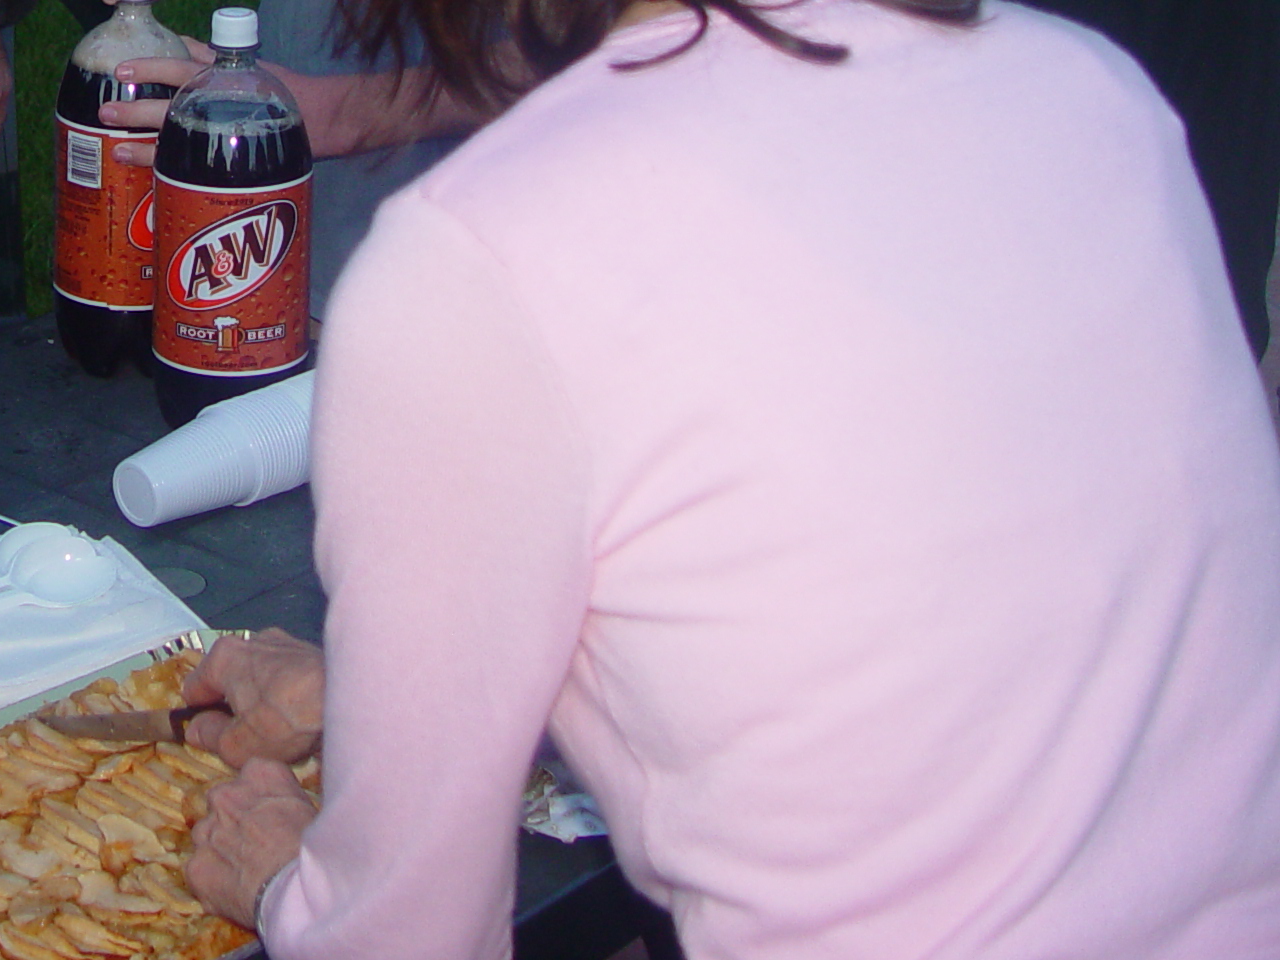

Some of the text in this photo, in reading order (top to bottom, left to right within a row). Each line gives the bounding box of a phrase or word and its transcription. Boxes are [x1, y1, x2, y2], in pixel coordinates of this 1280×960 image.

[183, 205, 278, 301] A&W
[179, 326, 283, 341] ROOT BEER
